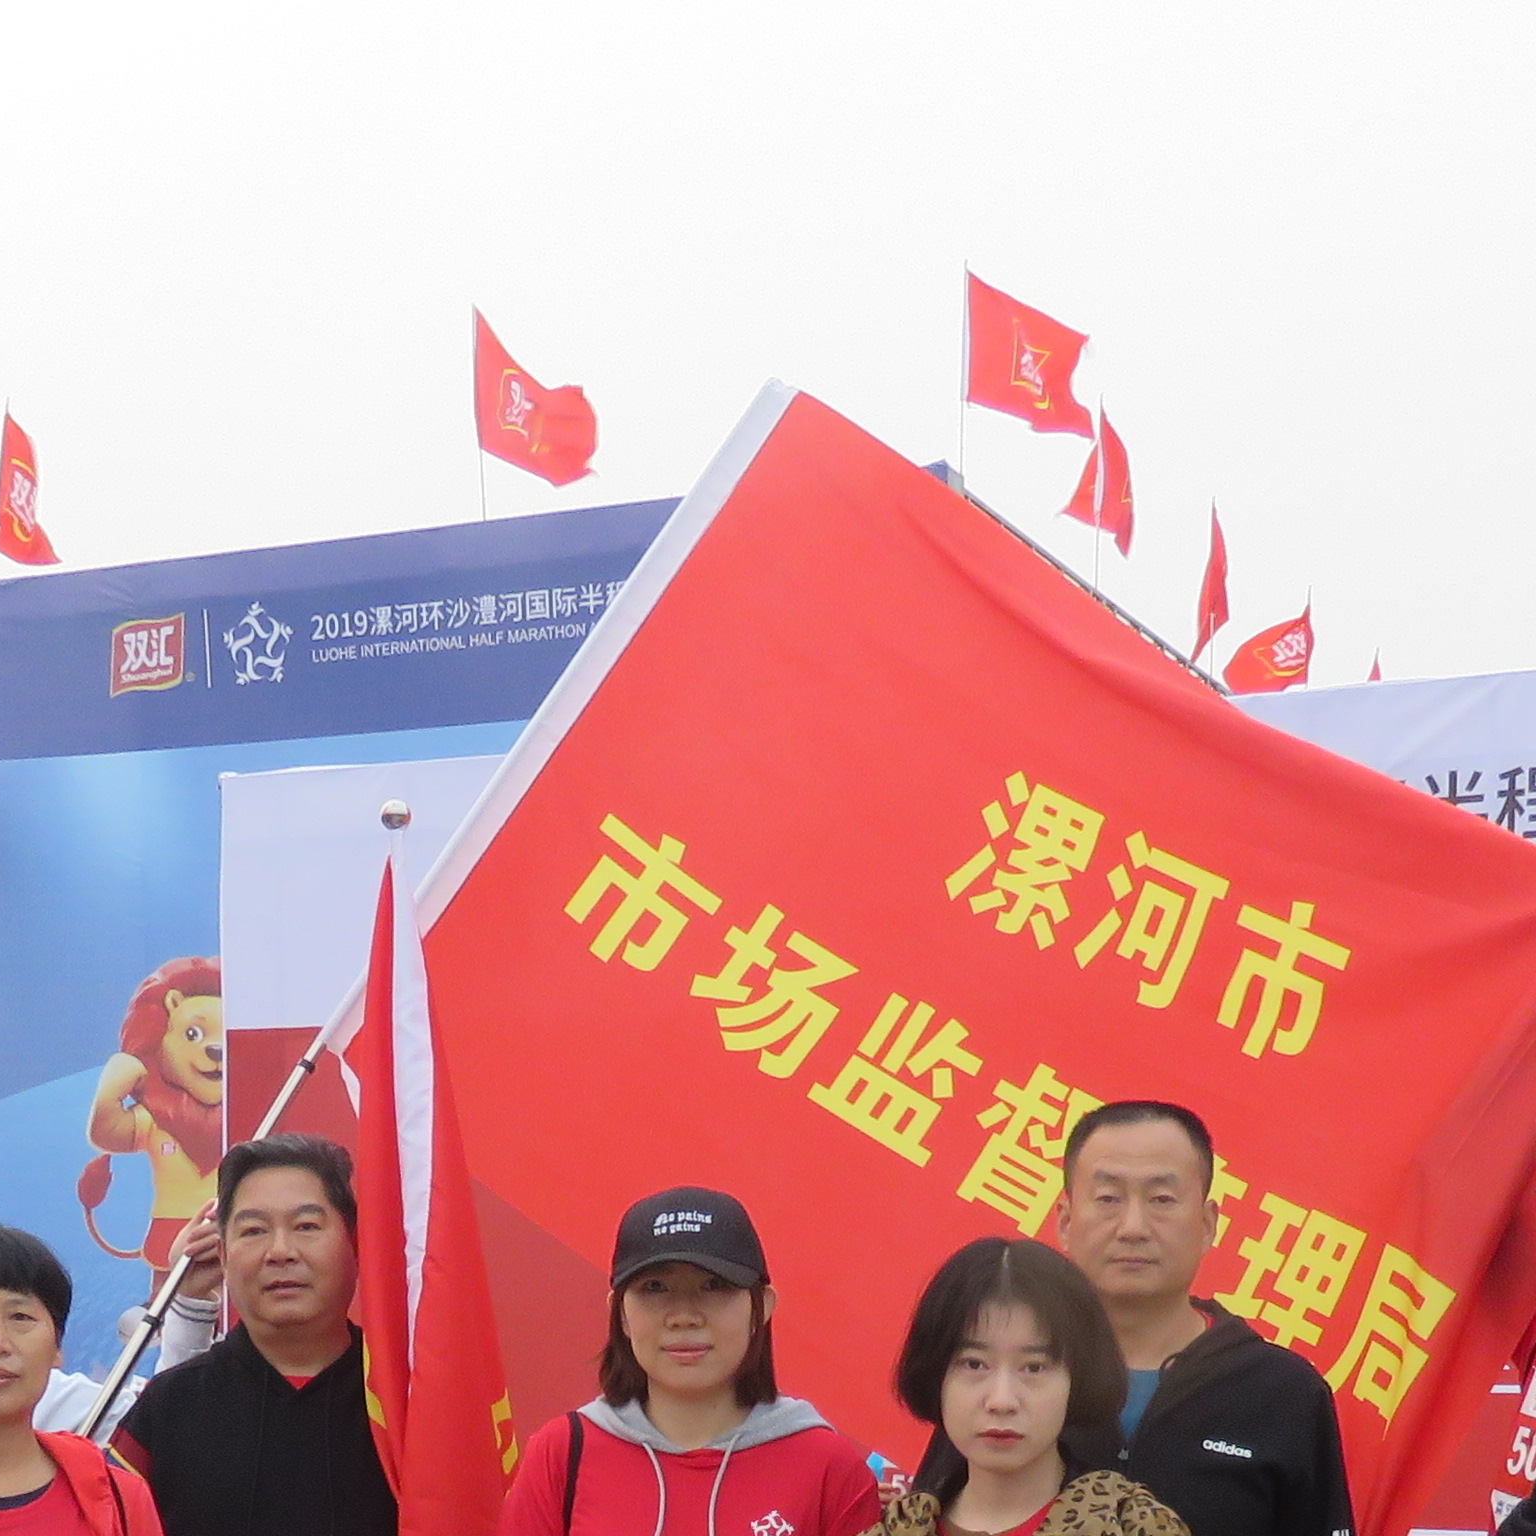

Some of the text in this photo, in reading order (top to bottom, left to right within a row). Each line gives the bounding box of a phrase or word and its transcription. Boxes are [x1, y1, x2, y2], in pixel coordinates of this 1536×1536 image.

[120, 625, 175, 673] 双汇
[312, 622, 586, 663] LUOHE INTERNATIONAL HALF MARATHON
[944, 770, 1351, 1059] 漯河市
[563, 813, 1457, 1440] 市场监督理局
[1202, 1439, 1252, 1459] adidas
